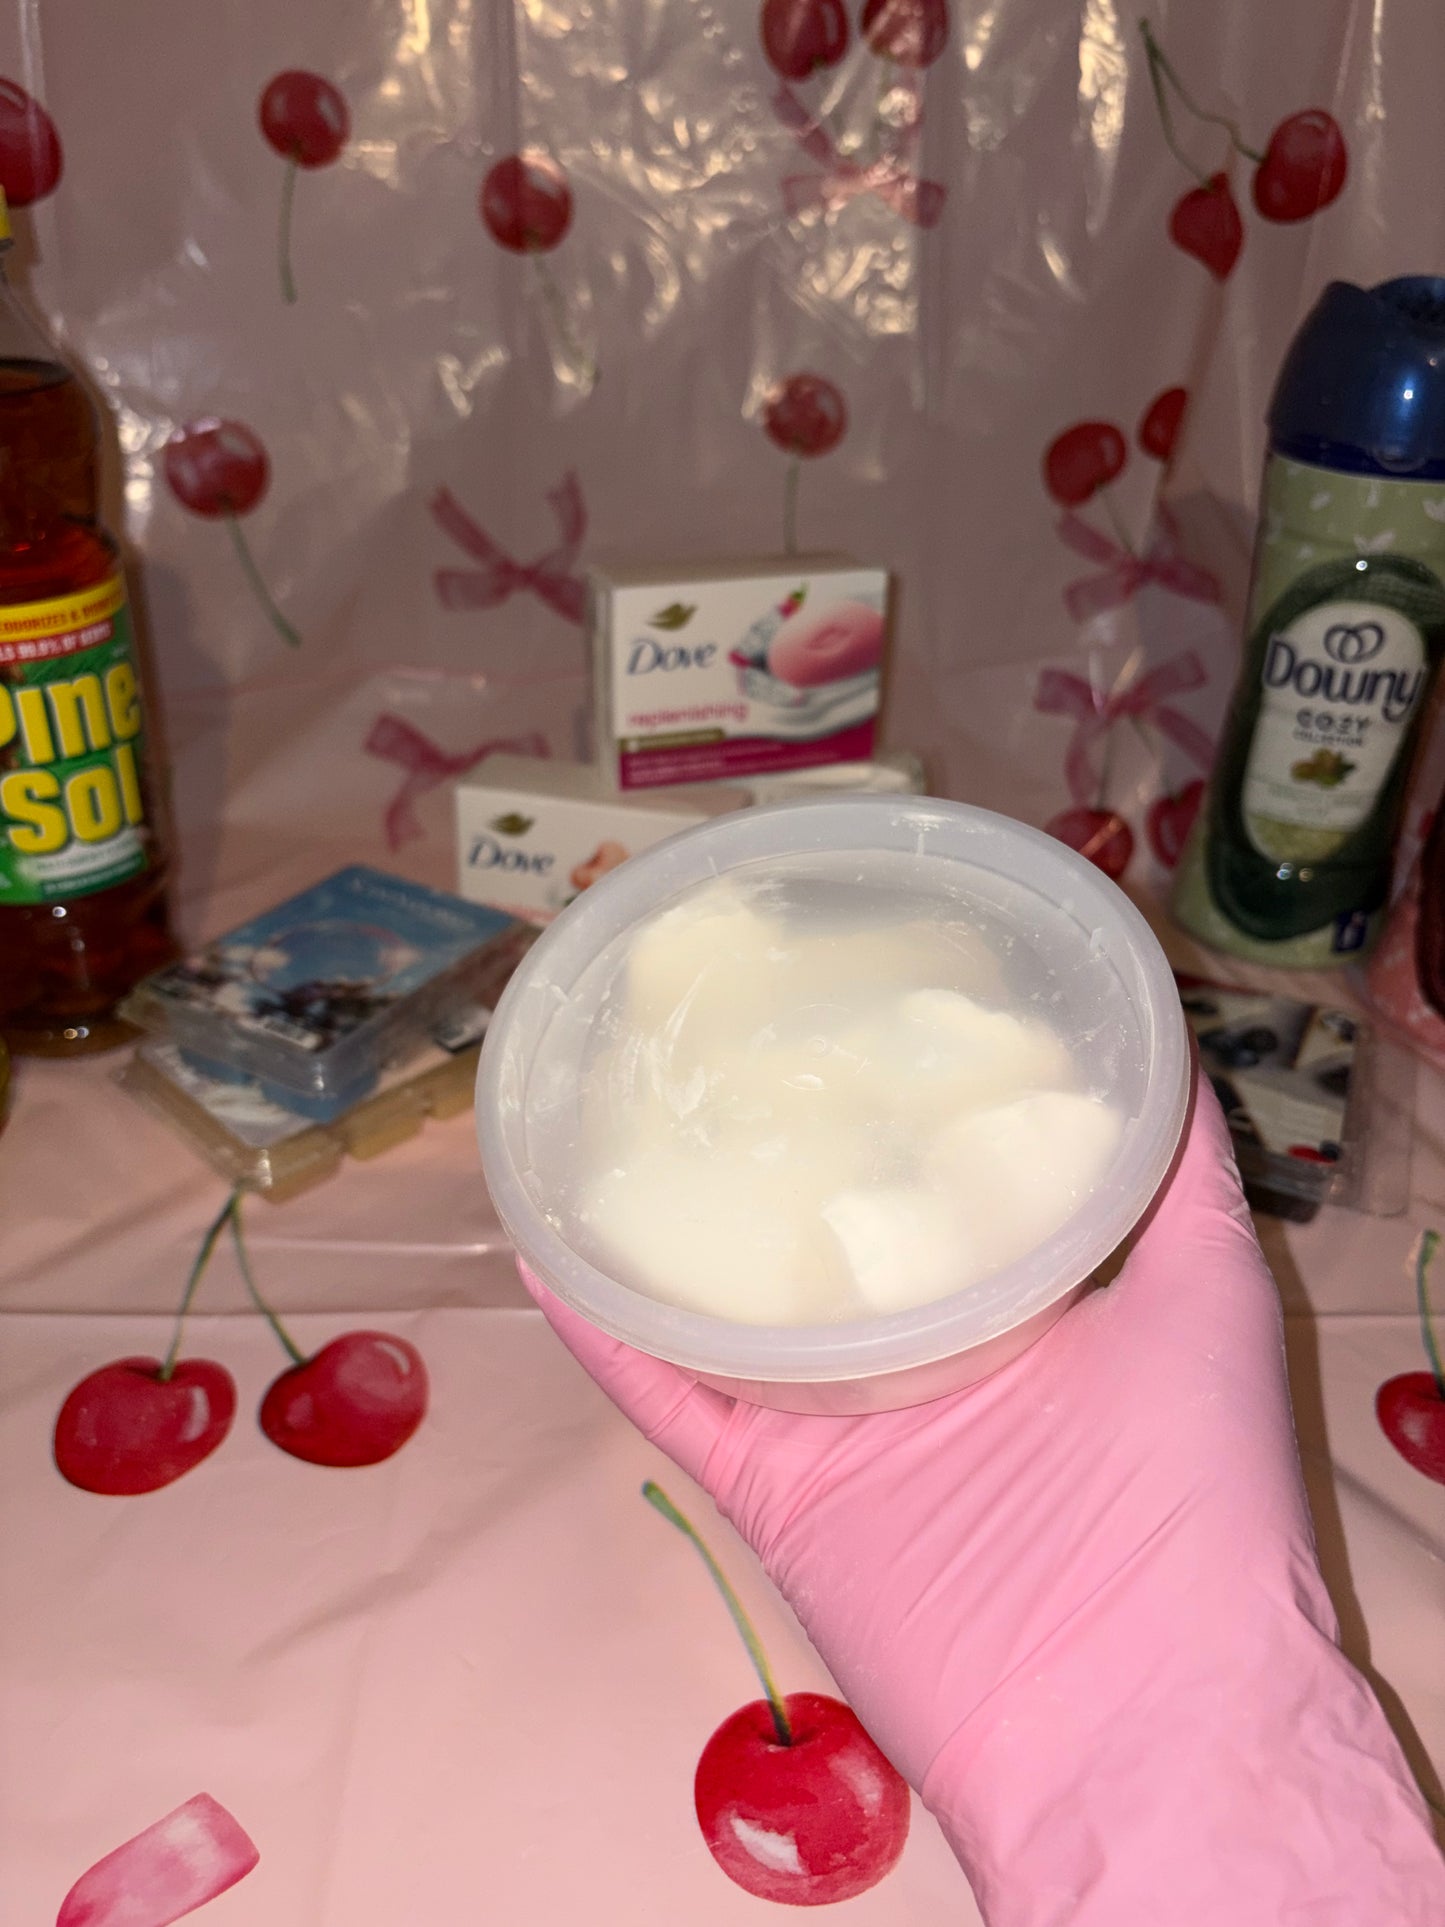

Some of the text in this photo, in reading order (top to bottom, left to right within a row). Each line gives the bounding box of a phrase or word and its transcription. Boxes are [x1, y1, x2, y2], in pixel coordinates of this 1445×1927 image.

[626, 637, 717, 676] Dove
[1262, 637, 1424, 723] Downy
[627, 701, 748, 732] replenishing
[1295, 707, 1372, 736] COZY
[468, 836, 555, 874] Dove
